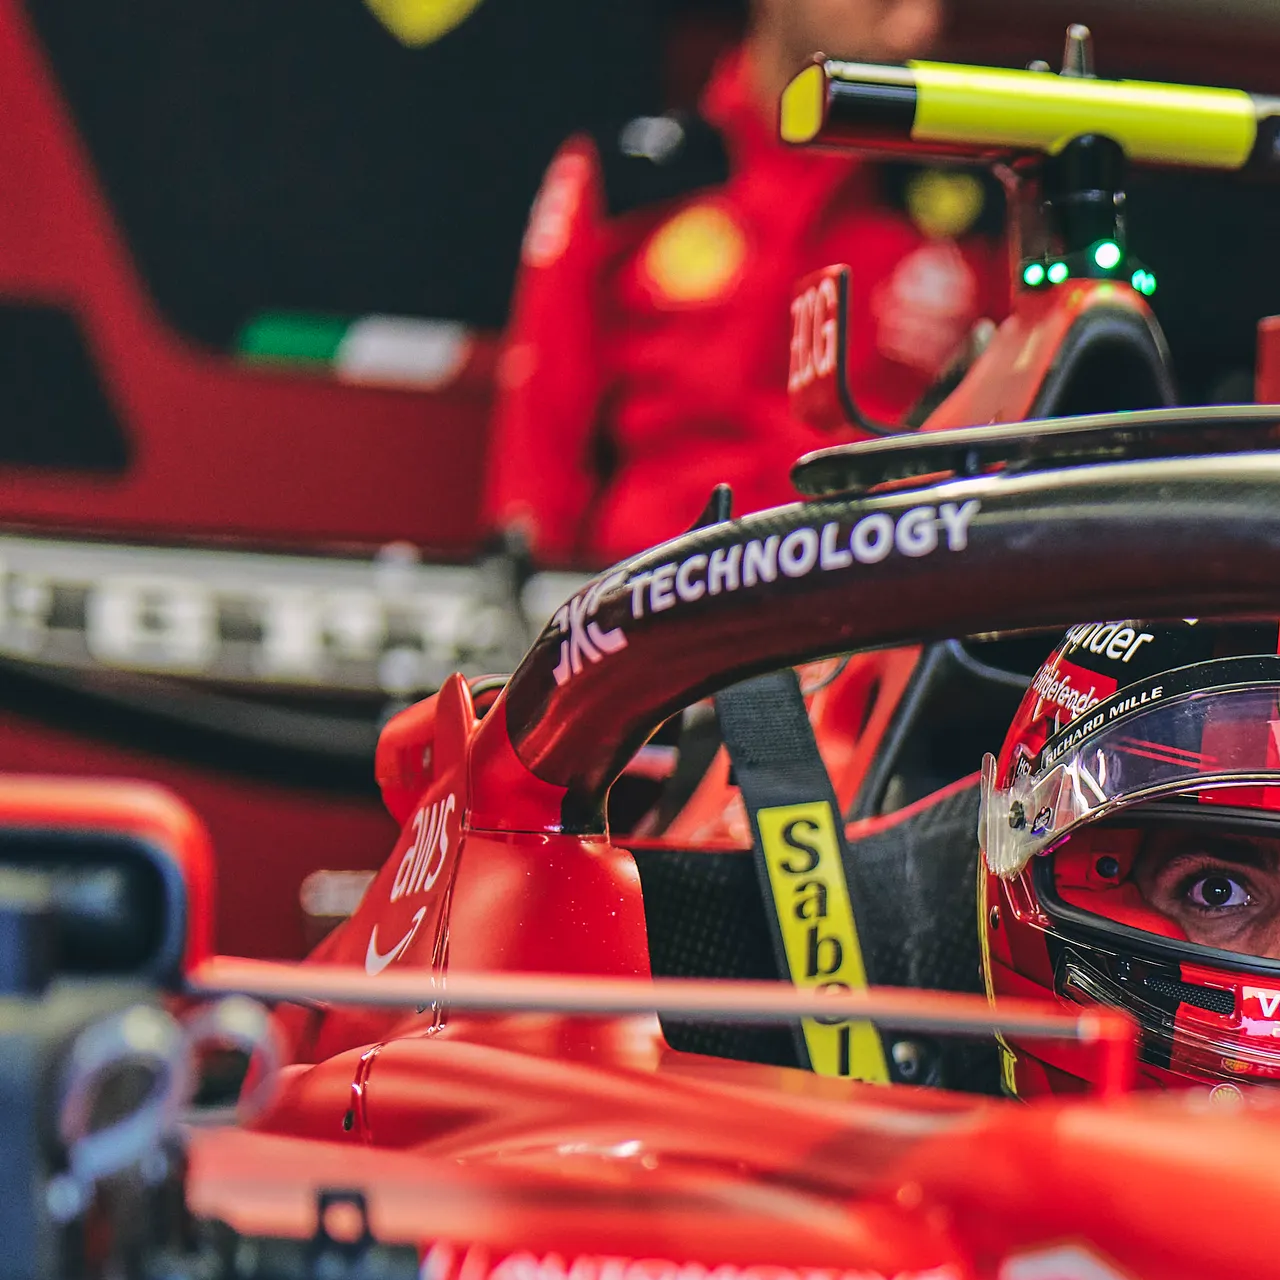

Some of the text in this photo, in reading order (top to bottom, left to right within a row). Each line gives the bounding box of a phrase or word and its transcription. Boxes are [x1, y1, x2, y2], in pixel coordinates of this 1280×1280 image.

[630, 500, 981, 620] TECHNOLOGY
[1046, 686, 1163, 763] RICHARD MILLE
[390, 793, 455, 903] aws
[781, 819, 864, 1081] Sabel
